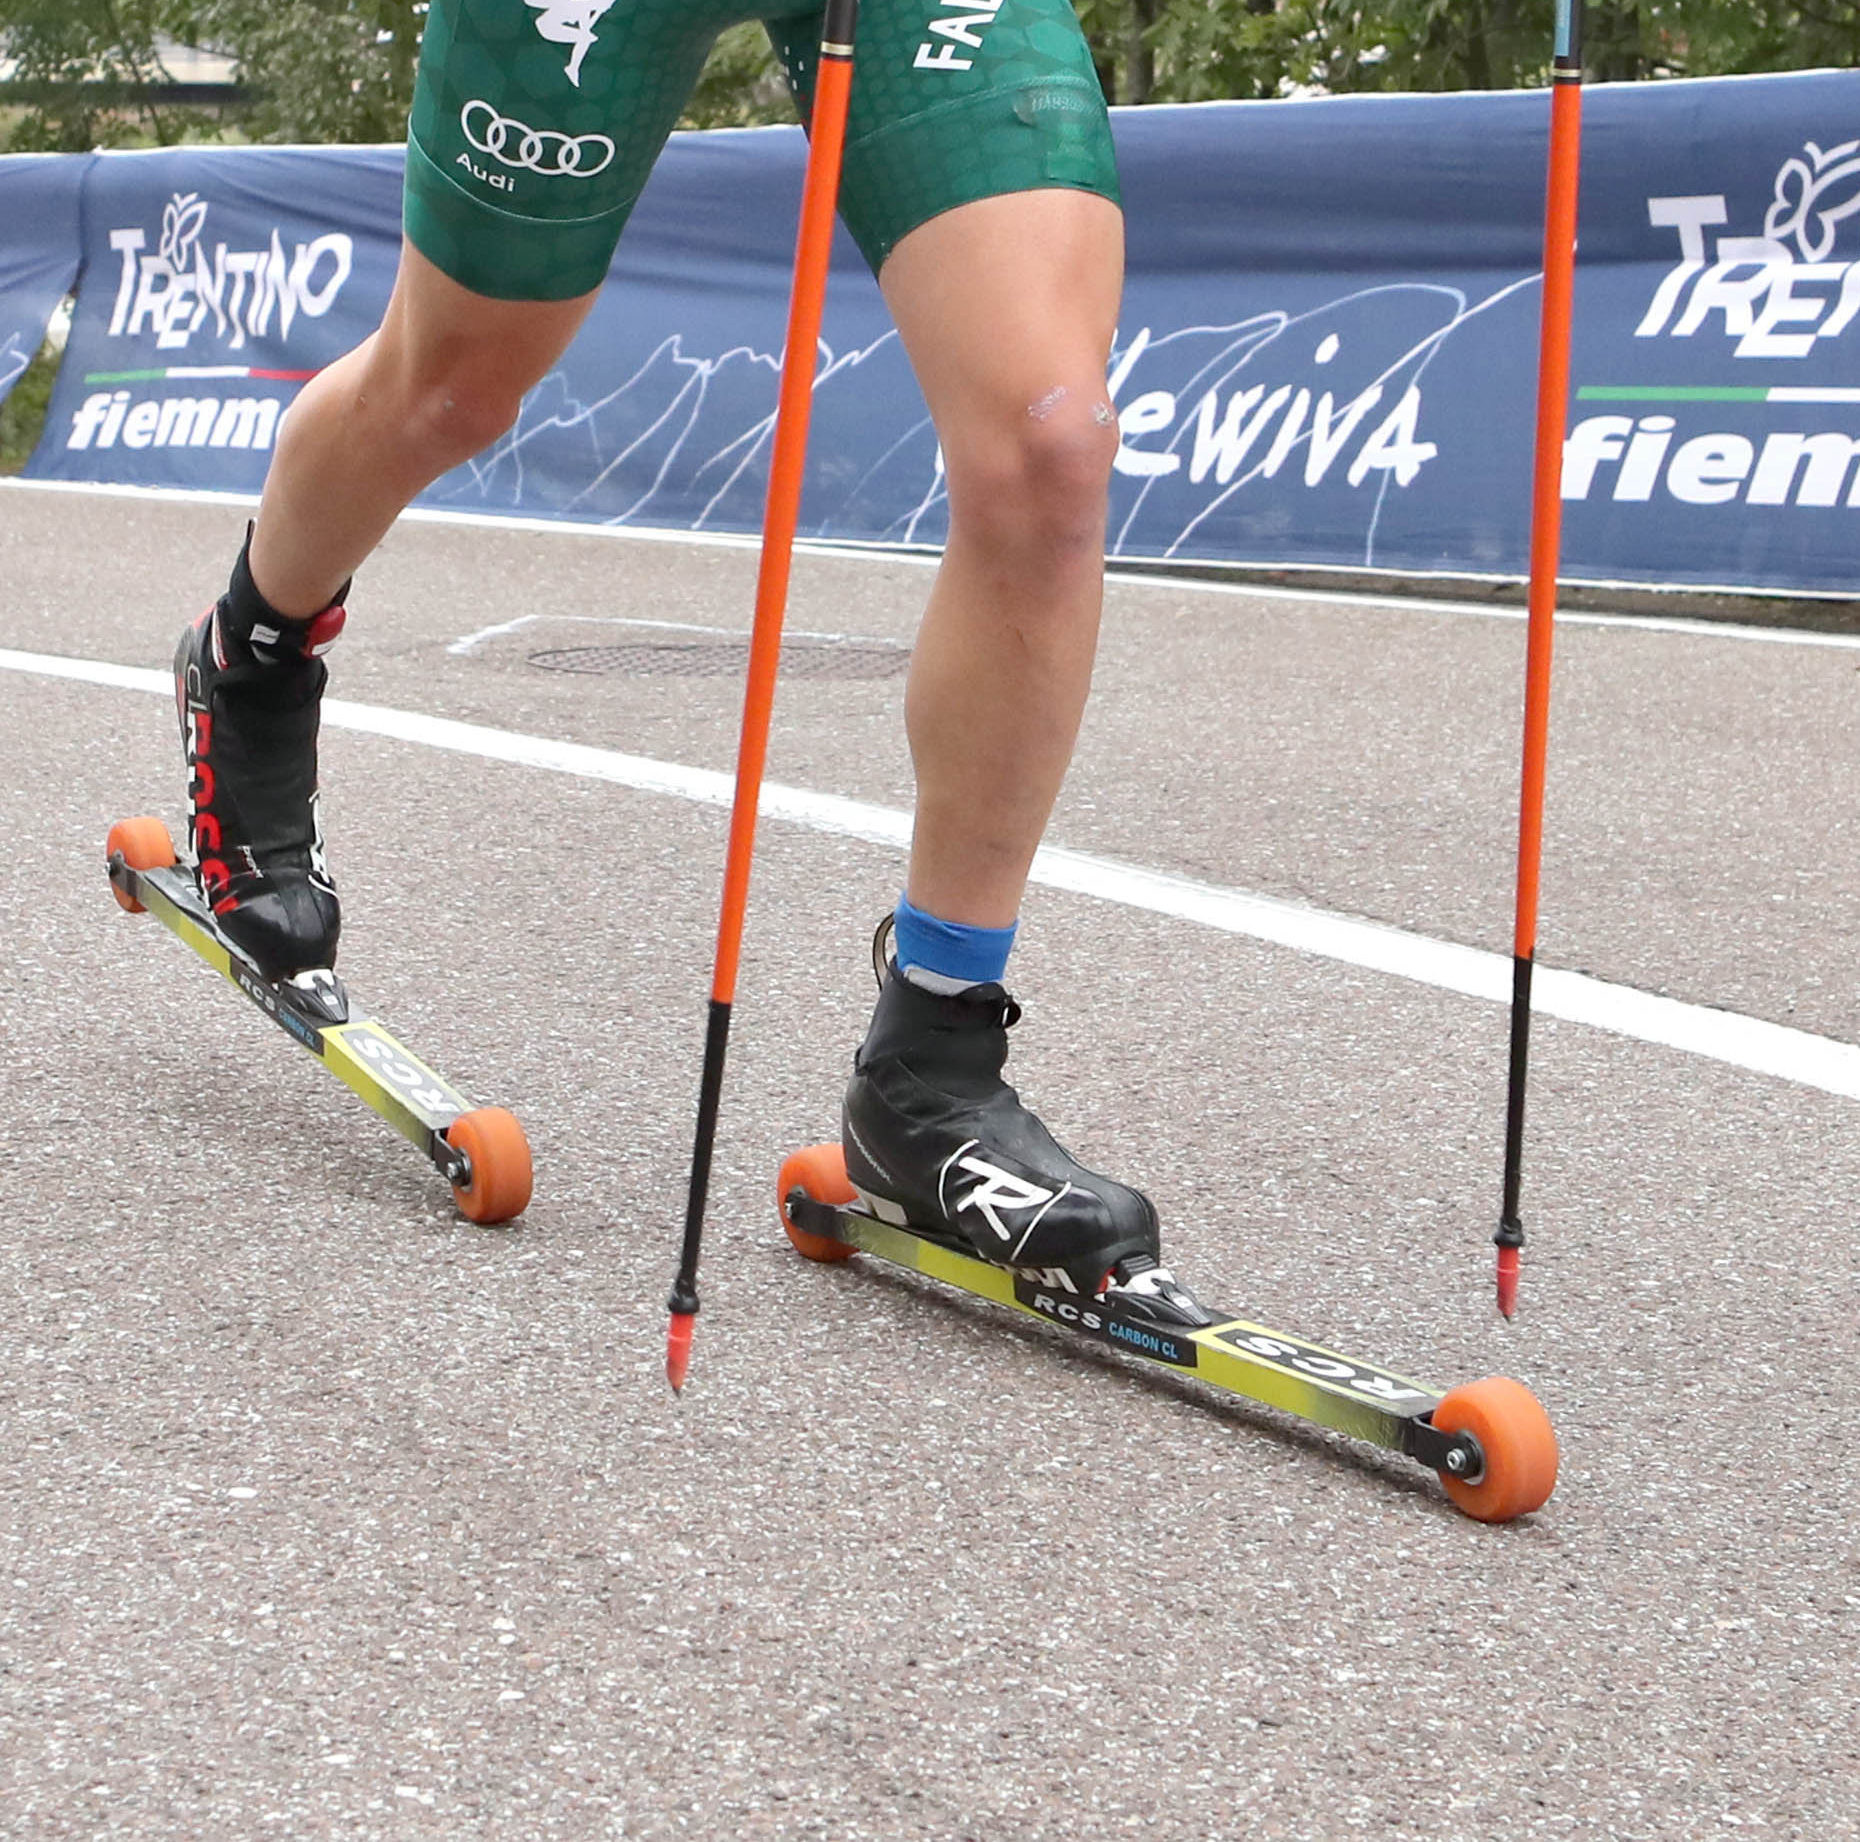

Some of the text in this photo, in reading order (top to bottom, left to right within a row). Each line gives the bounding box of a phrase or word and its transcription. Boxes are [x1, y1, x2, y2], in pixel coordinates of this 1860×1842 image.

[456, 152, 516, 192] Audi
[108, 227, 354, 349] TRENTINO
[66, 390, 286, 450] fiemm
[239, 973, 276, 1012] RCS
[353, 1037, 462, 1113] RCS
[1033, 1293, 1179, 1359] RCS CARBON CL
[1235, 1335, 1429, 1400] RCS
